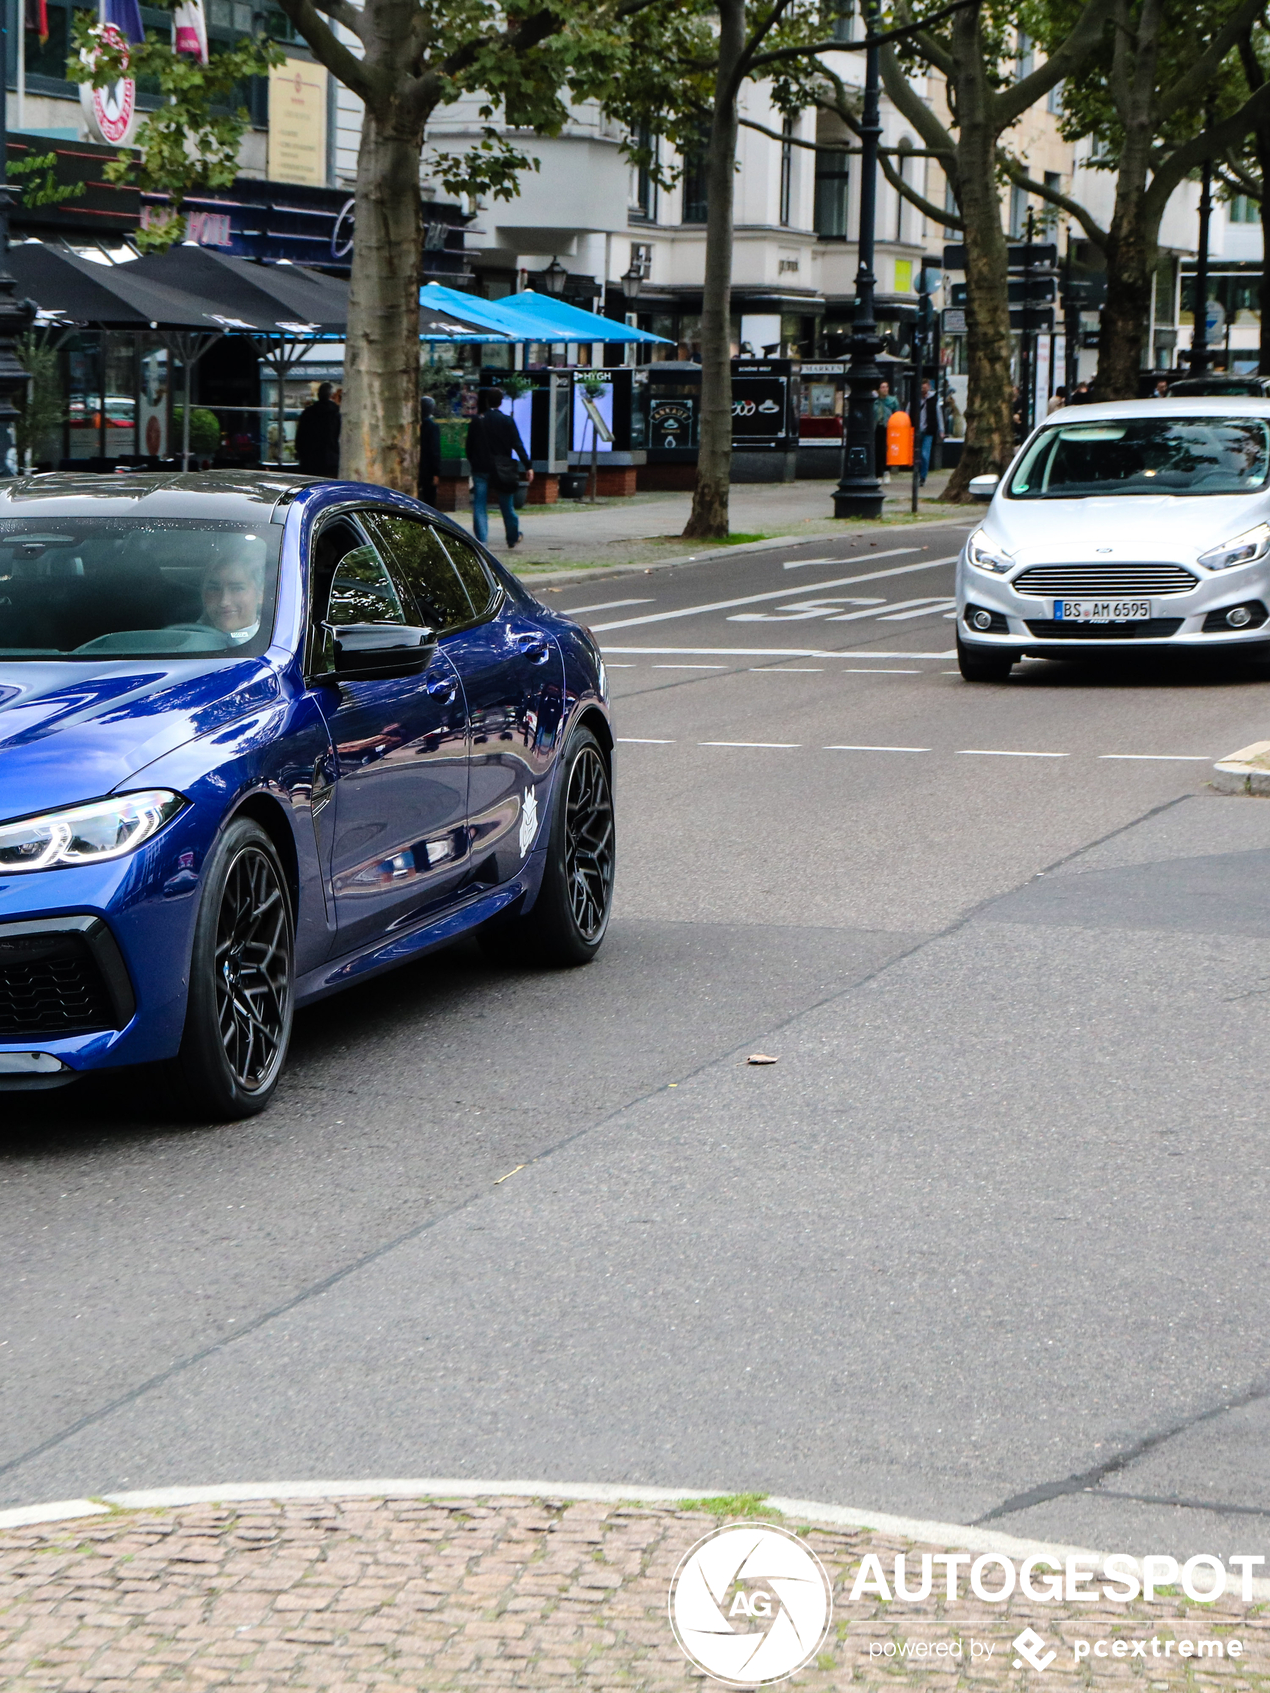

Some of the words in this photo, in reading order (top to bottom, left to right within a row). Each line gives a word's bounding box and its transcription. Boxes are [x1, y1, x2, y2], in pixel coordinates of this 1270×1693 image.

[584, 372, 611, 380] HYGH
[654, 408, 689, 420] ANKAUF
[1064, 603, 1081, 617] BS
[1092, 603, 1110, 617] AM
[1114, 602, 1148, 617] 6595
